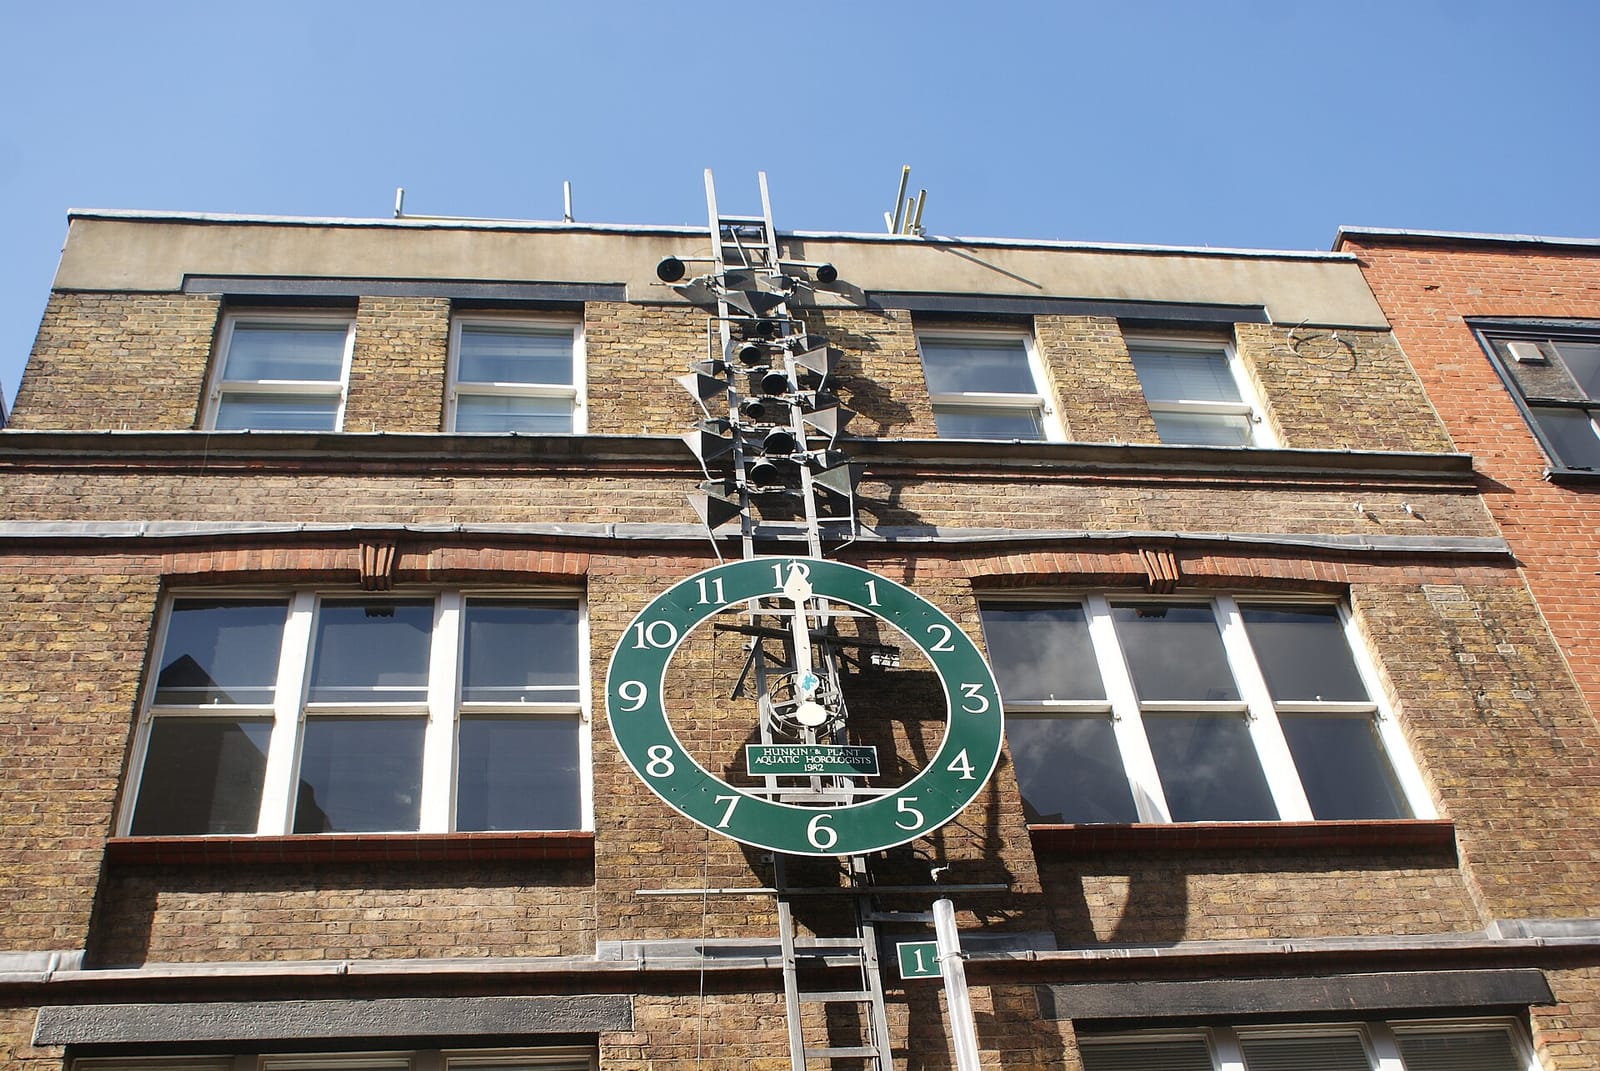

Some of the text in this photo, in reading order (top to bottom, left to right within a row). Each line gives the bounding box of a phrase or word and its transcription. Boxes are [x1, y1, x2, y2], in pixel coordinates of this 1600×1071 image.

[696, 577, 727, 605] 11
[865, 579, 882, 607] 1
[632, 620, 678, 650] 10
[926, 623, 955, 652] 2
[618, 680, 648, 712] 9
[960, 682, 990, 714] 3
[645, 744, 675, 778] 8
[755, 756, 871, 765] AQUATIC HOROLOGISTS
[763, 748, 808, 756] HUNKIN
[827, 748, 860, 756] PLANT
[946, 747, 977, 780] 4
[804, 764, 824, 772] 1982
[713, 794, 742, 829] 7
[895, 796, 924, 831] 5
[806, 813, 838, 849] 6
[913, 948, 929, 973] 1
